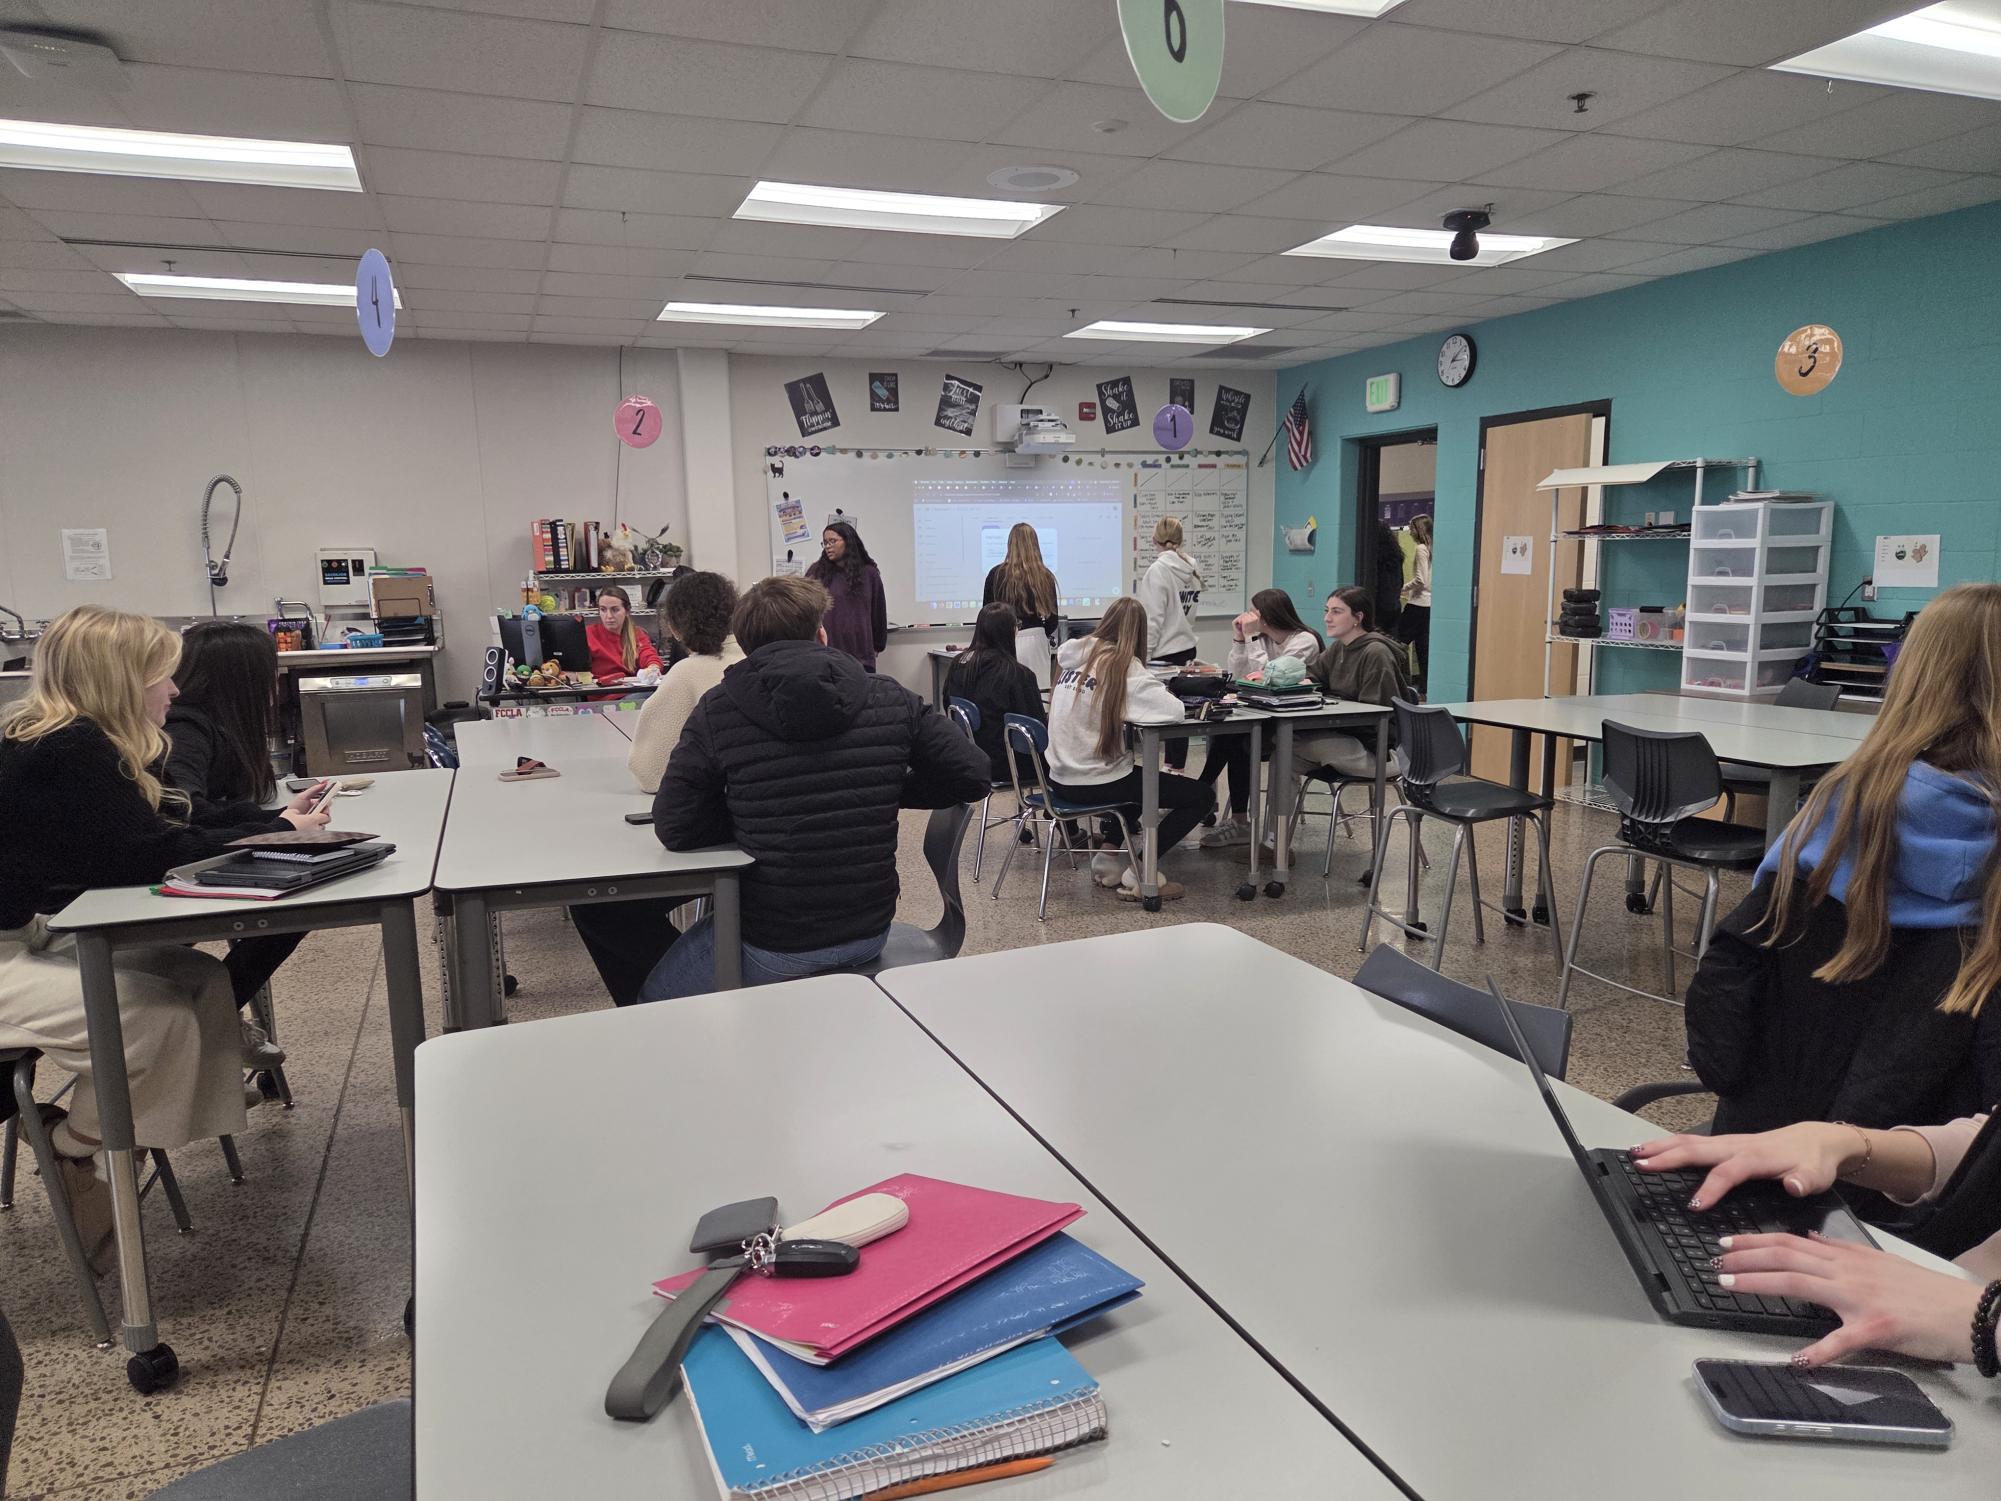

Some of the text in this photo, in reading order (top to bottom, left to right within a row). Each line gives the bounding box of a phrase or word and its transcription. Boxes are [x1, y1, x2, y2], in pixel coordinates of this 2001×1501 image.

[371, 274, 381, 328] 4
[1798, 342, 1819, 377] 3
[1101, 381, 1129, 399] Shake
[632, 409, 645, 436] 2
[1107, 411, 1135, 427] Shake
[1114, 420, 1132, 430] IT UP
[1170, 414, 1177, 438] 1
[495, 708, 523, 718] FCCLA
